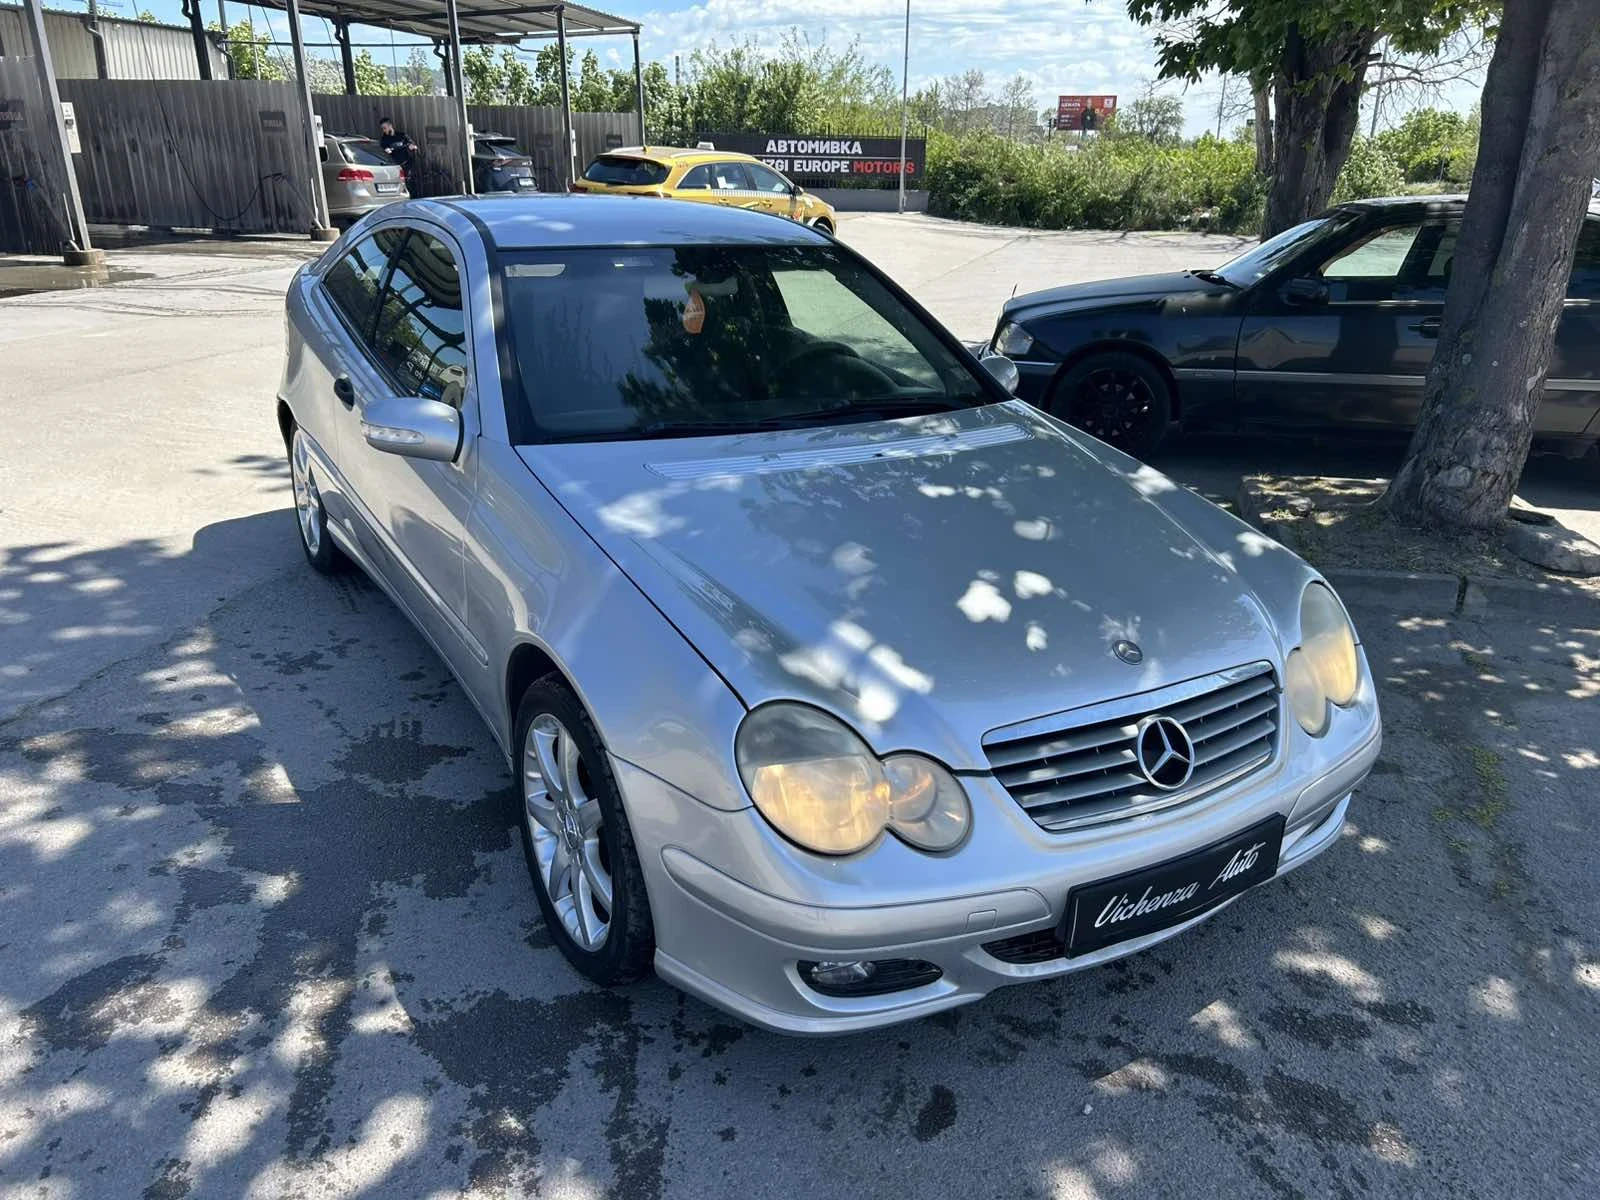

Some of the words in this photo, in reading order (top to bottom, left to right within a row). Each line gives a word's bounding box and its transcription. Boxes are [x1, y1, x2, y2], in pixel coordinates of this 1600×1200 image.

[765, 139, 863, 154] АВТОМИВКА
[793, 159, 849, 173] EUROPE
[853, 160, 916, 174] MOTORS
[1094, 881, 1200, 928] Vichenza
[1208, 841, 1266, 890] Auto
